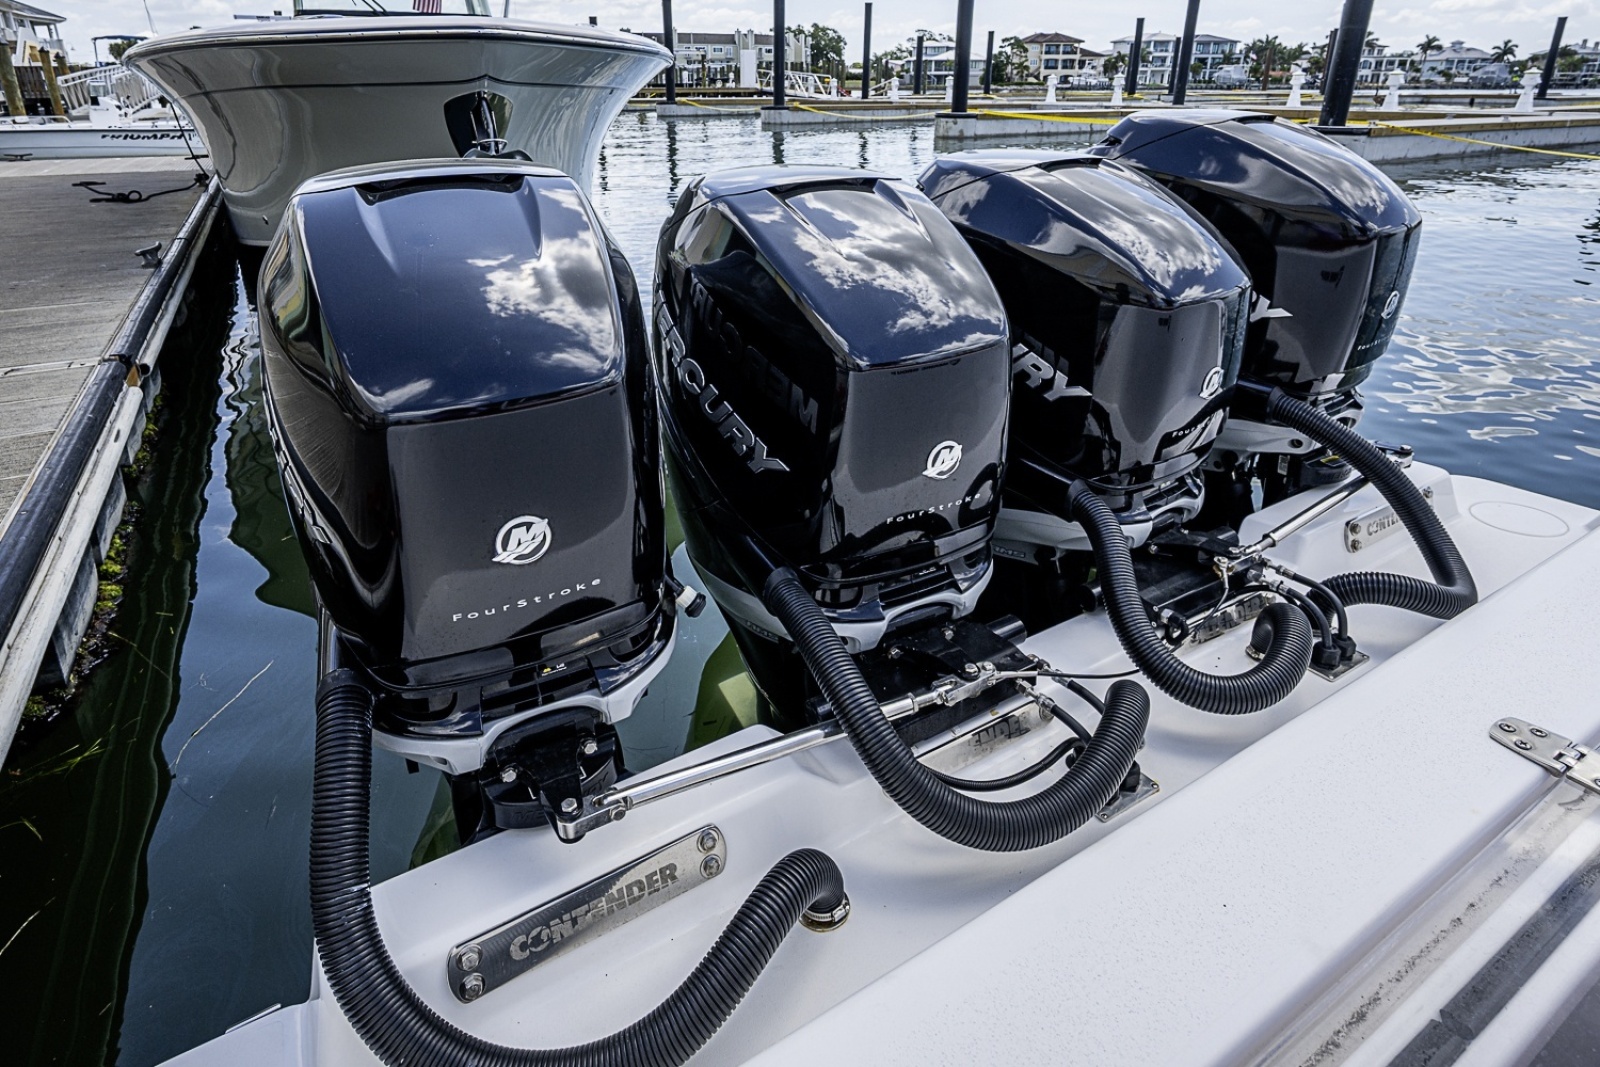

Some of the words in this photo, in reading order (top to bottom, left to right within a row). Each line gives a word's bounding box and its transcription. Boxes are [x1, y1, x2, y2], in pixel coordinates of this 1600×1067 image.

[886, 493, 981, 524] FourStroke
[1367, 512, 1399, 537] CONTE
[452, 578, 601, 622] FourStroke
[510, 862, 679, 961] CONTENDER
